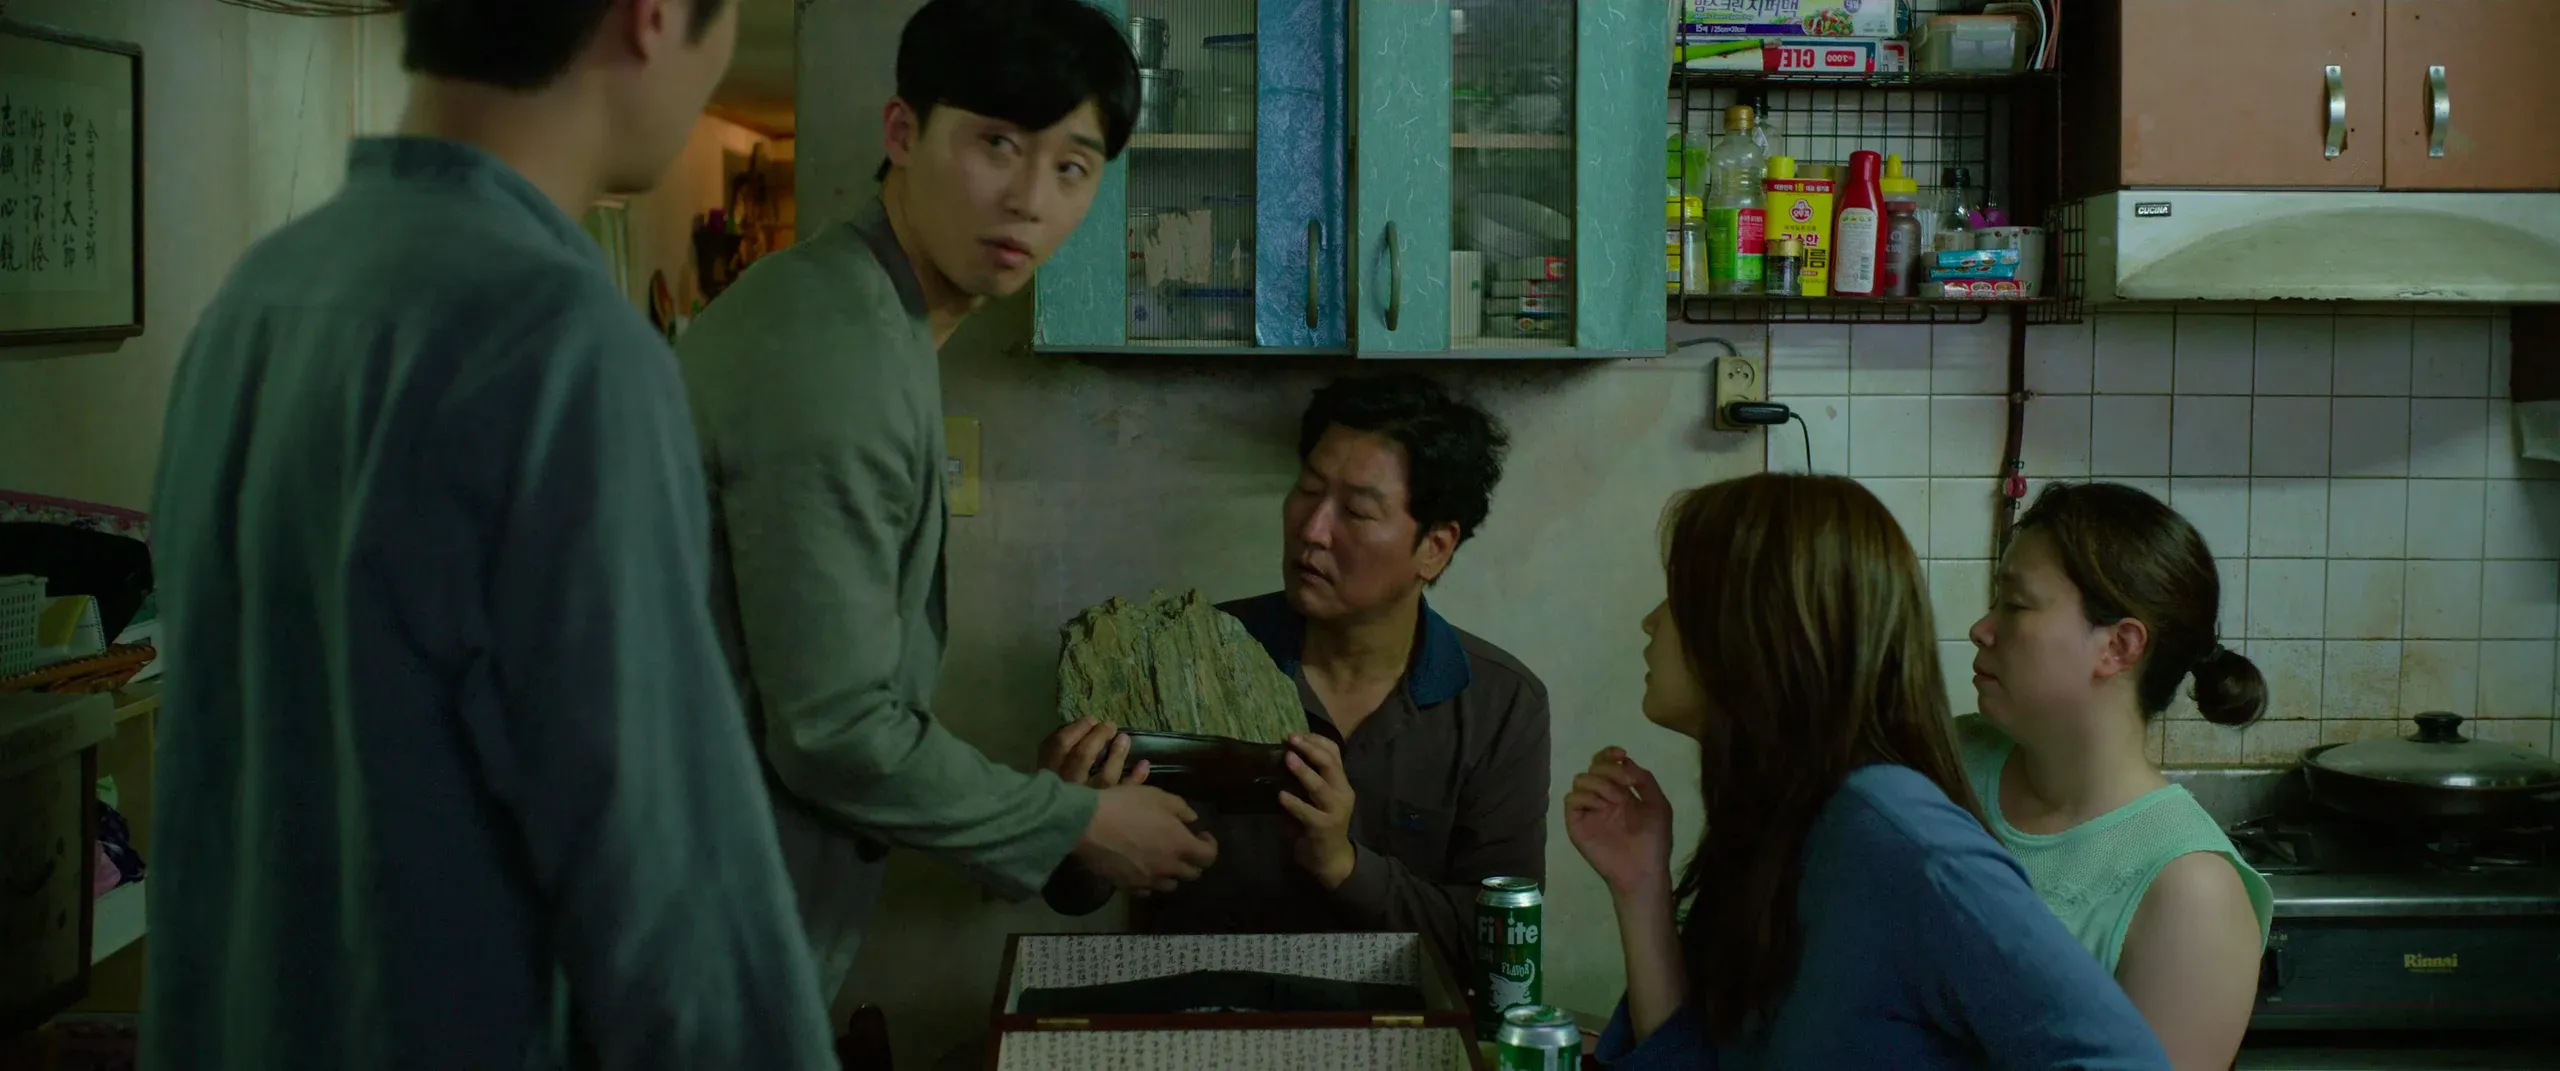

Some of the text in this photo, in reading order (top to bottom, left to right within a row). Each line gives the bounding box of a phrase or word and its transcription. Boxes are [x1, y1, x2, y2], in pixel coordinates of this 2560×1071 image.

[1778, 49, 1816, 69] CLE
[2137, 206, 2168, 214] CUCINA
[2403, 952, 2459, 969] Rinnai
[1501, 961, 1530, 978] FLAVOR
